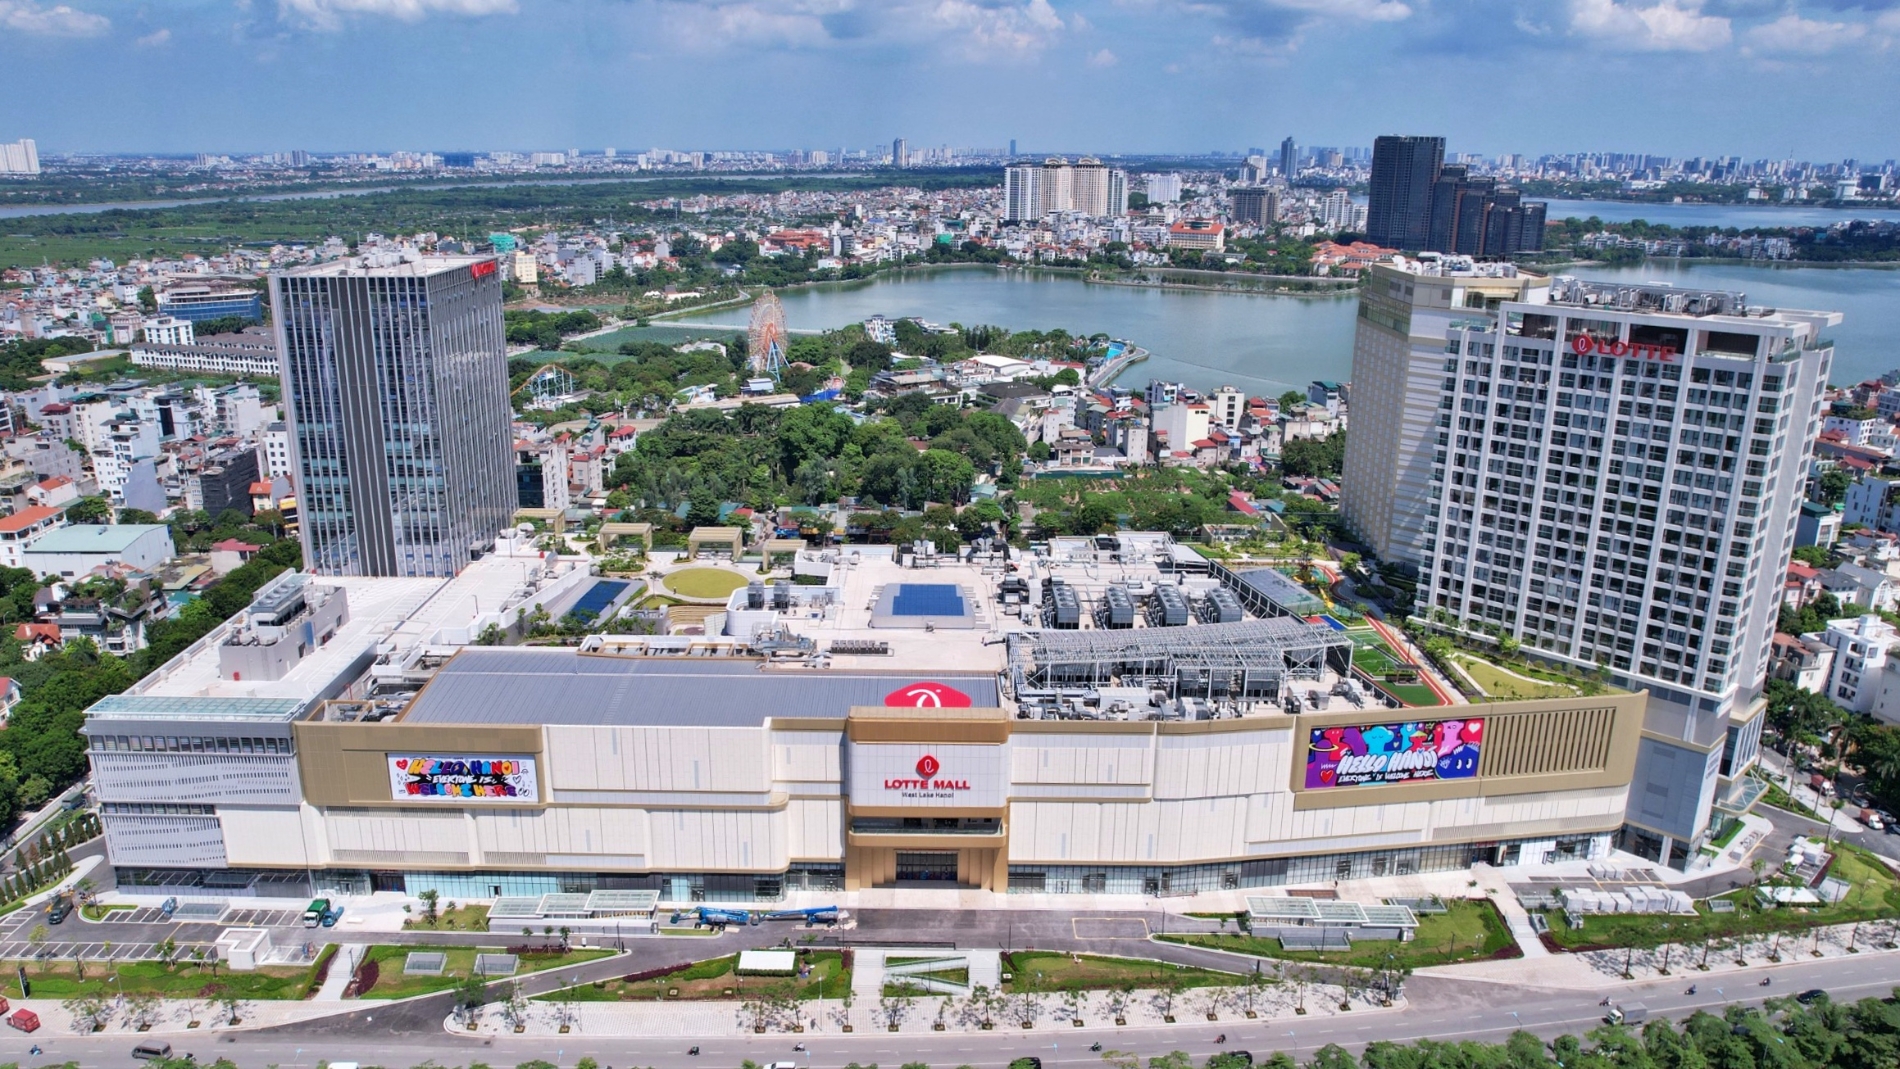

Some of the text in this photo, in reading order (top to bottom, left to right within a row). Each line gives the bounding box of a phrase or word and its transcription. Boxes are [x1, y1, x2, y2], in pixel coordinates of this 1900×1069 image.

[1597, 339, 1676, 361] LOTTE
[470, 760, 519, 775] HANOI
[1336, 750, 1438, 774] HELLO HANOI
[405, 782, 517, 797] WELCOME HERE
[884, 779, 970, 790] LOTTE MALL
